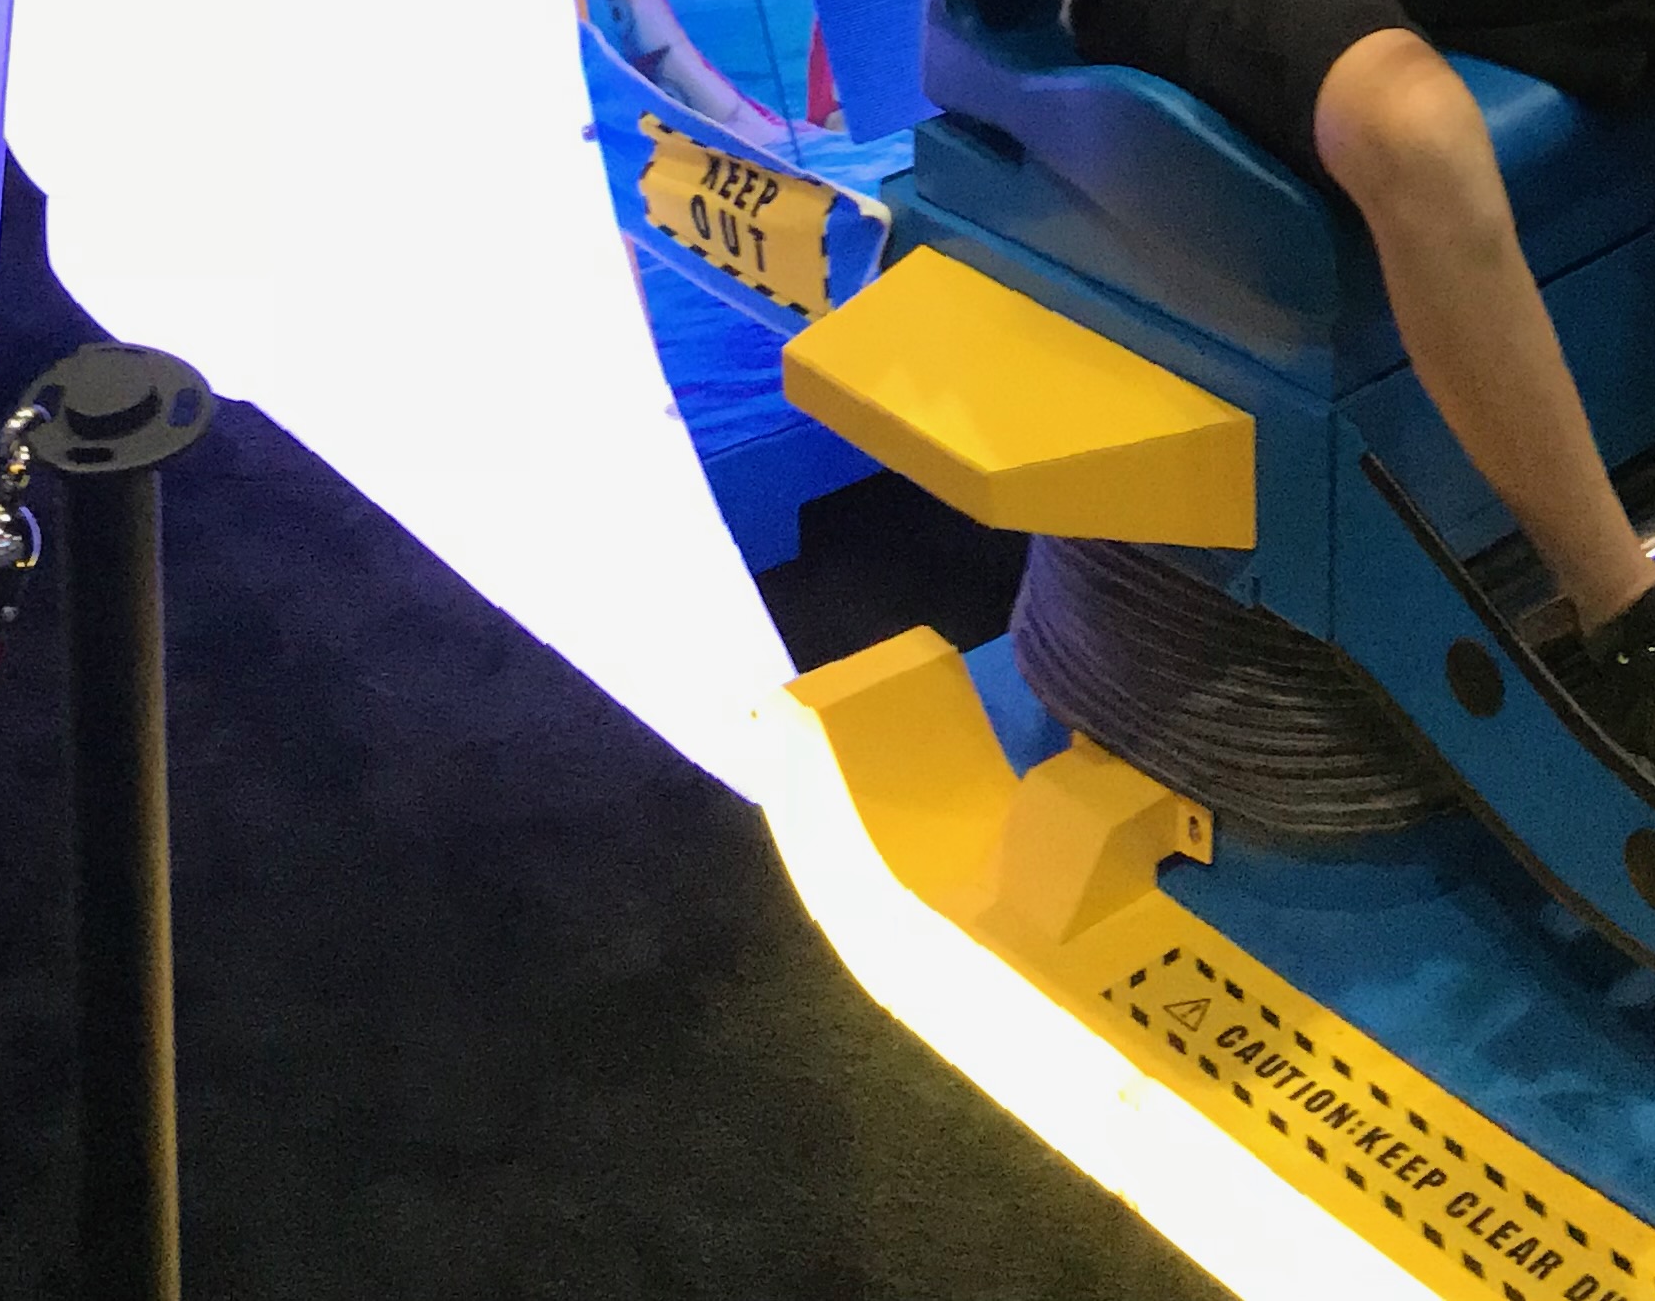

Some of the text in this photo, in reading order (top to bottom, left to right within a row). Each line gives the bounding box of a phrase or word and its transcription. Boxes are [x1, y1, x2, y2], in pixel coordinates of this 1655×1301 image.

[701, 153, 779, 217] KEEP
[690, 194, 767, 273] OUT
[1444, 1190, 1564, 1281] CLEAR
